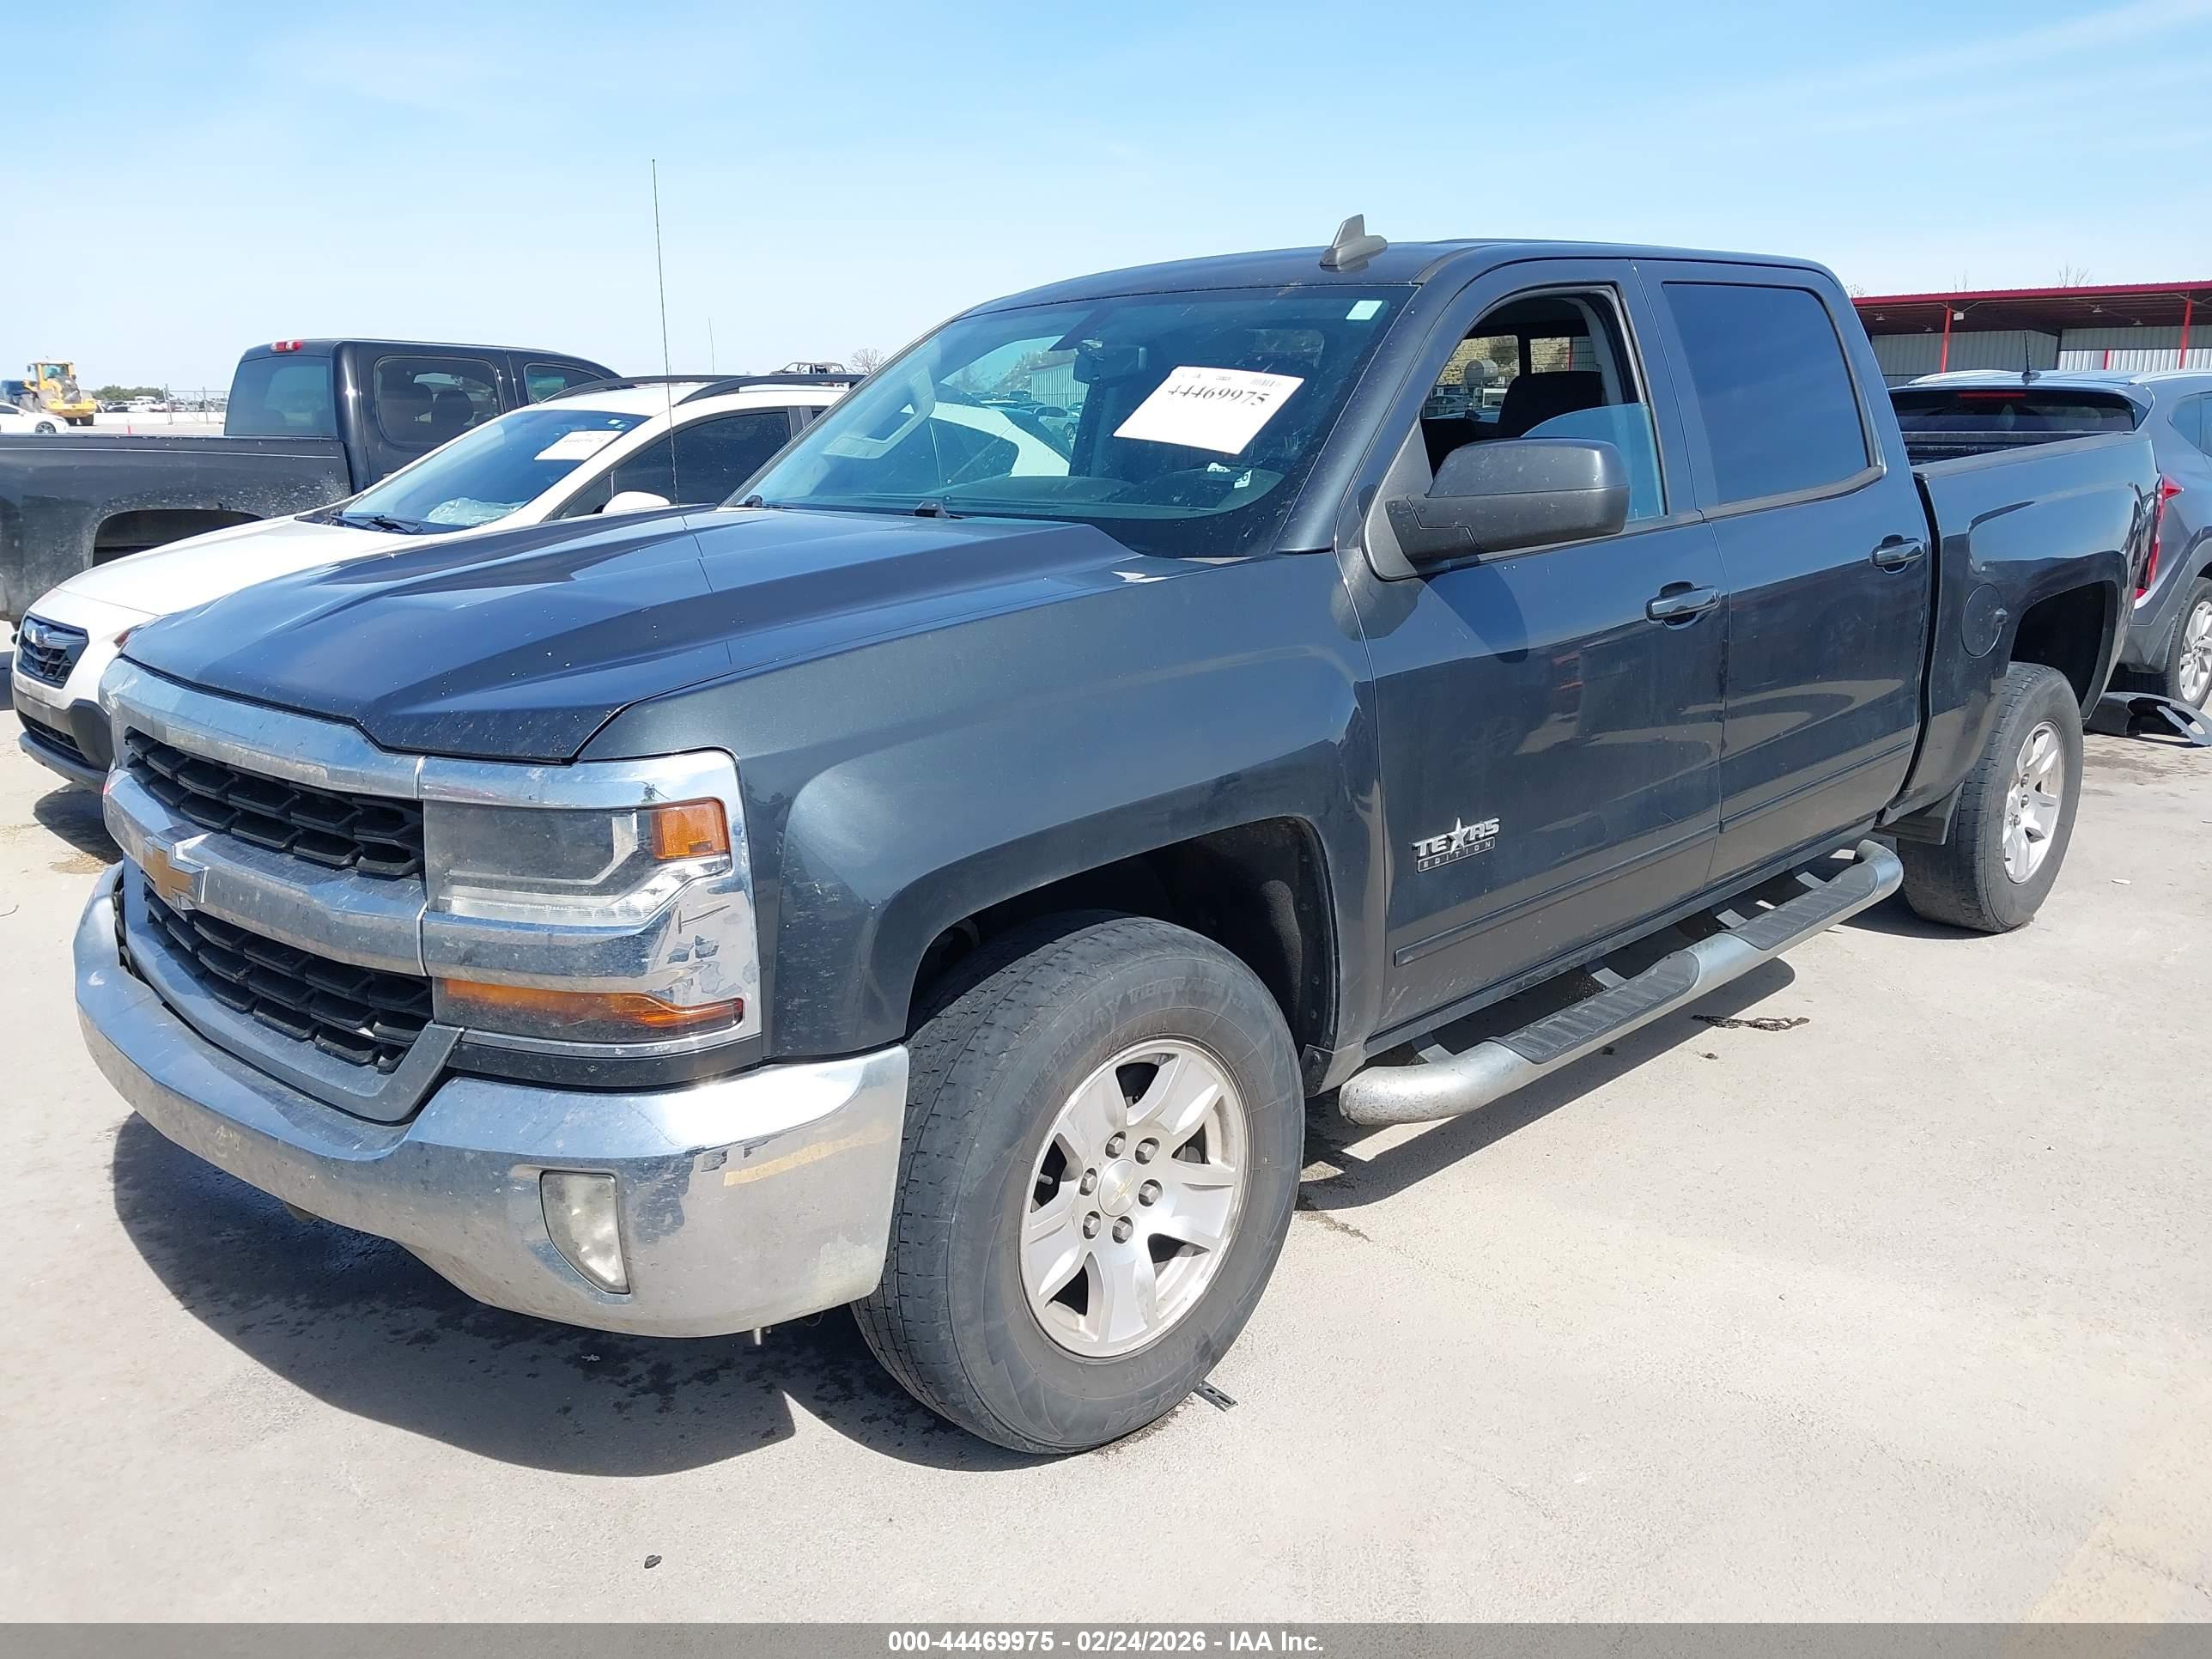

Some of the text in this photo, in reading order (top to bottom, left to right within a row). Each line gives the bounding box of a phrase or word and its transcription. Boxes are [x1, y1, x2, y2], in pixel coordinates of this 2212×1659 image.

[1167, 384, 1272, 406] 44469975
[1412, 817, 1500, 857] TEXAS
[1422, 840, 1492, 868] EDITION
